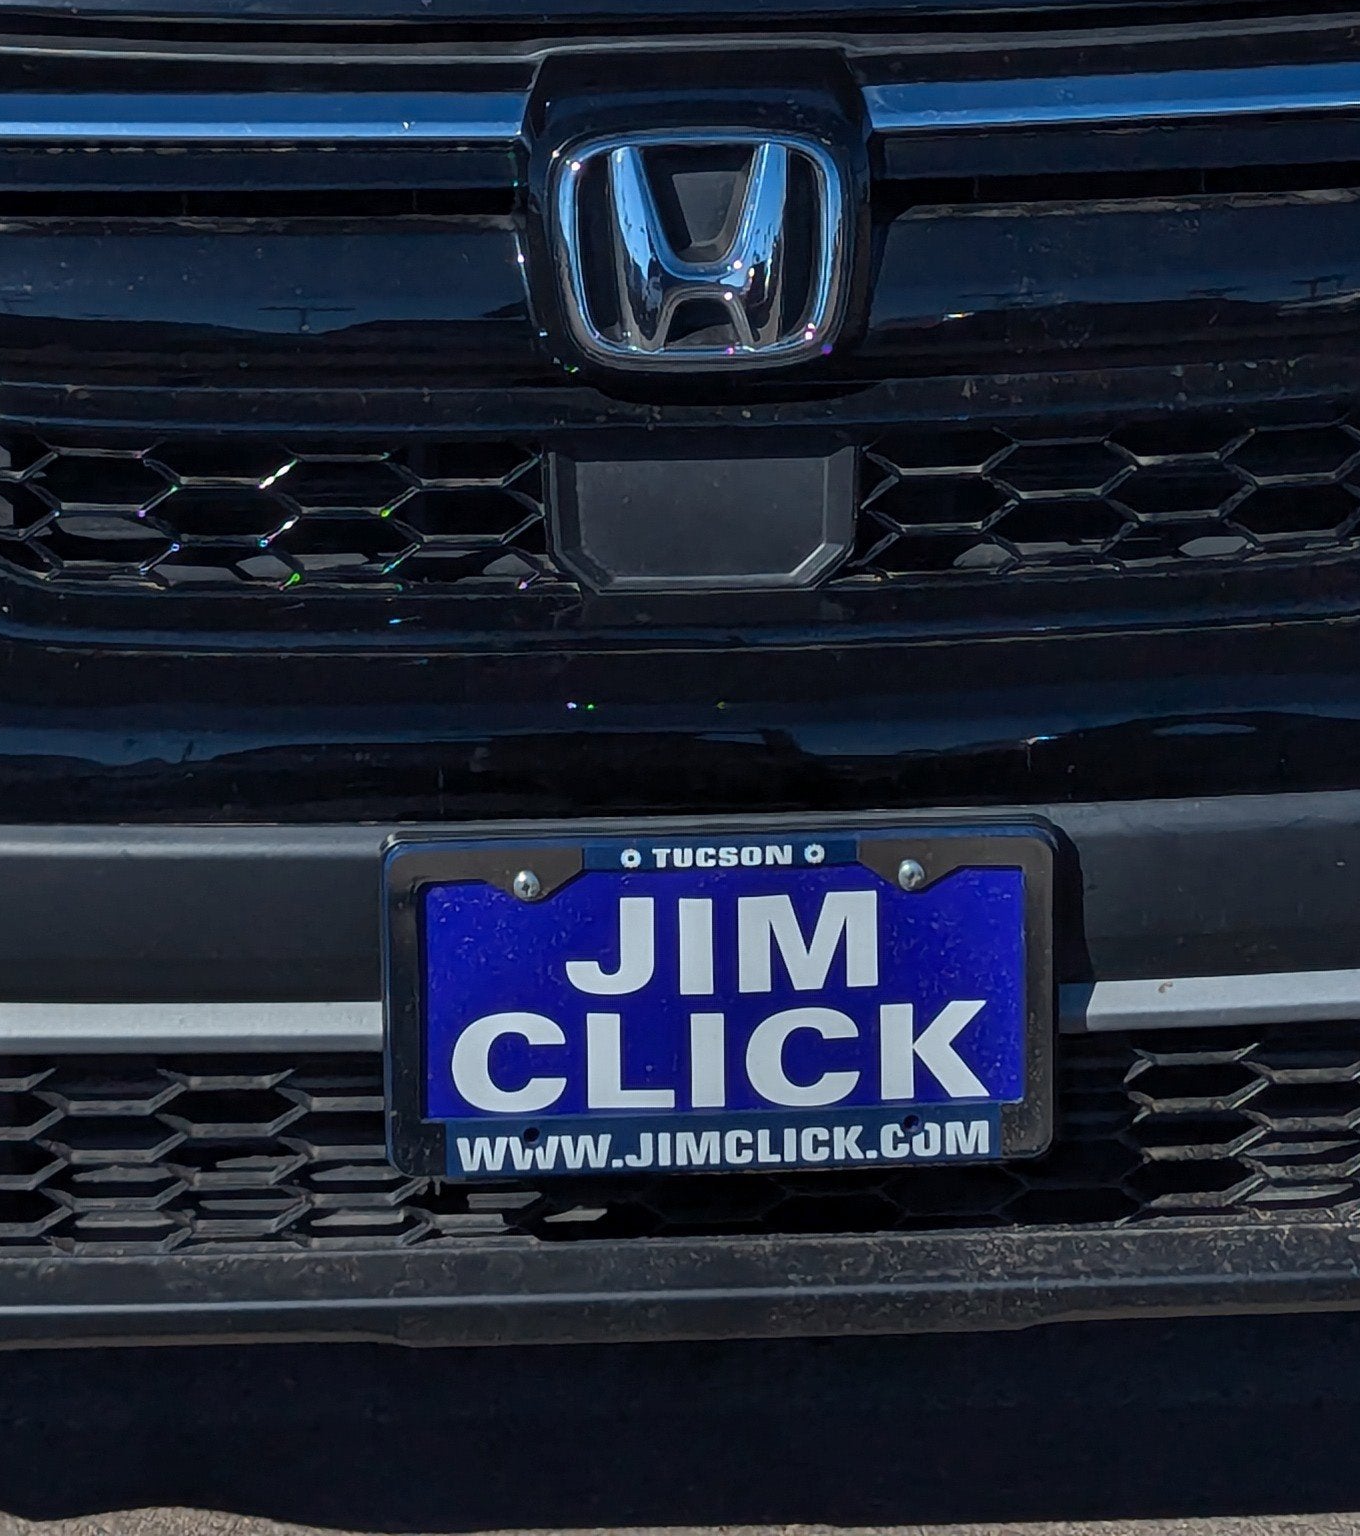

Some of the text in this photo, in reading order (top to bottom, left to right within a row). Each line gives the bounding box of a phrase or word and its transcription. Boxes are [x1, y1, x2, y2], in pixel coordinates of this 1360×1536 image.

[652, 844, 793, 869] TUCSON
[565, 890, 879, 997] JIM
[451, 1000, 990, 1113] CLICK
[456, 1119, 990, 1172] WWW.JIMCLICK.COM
